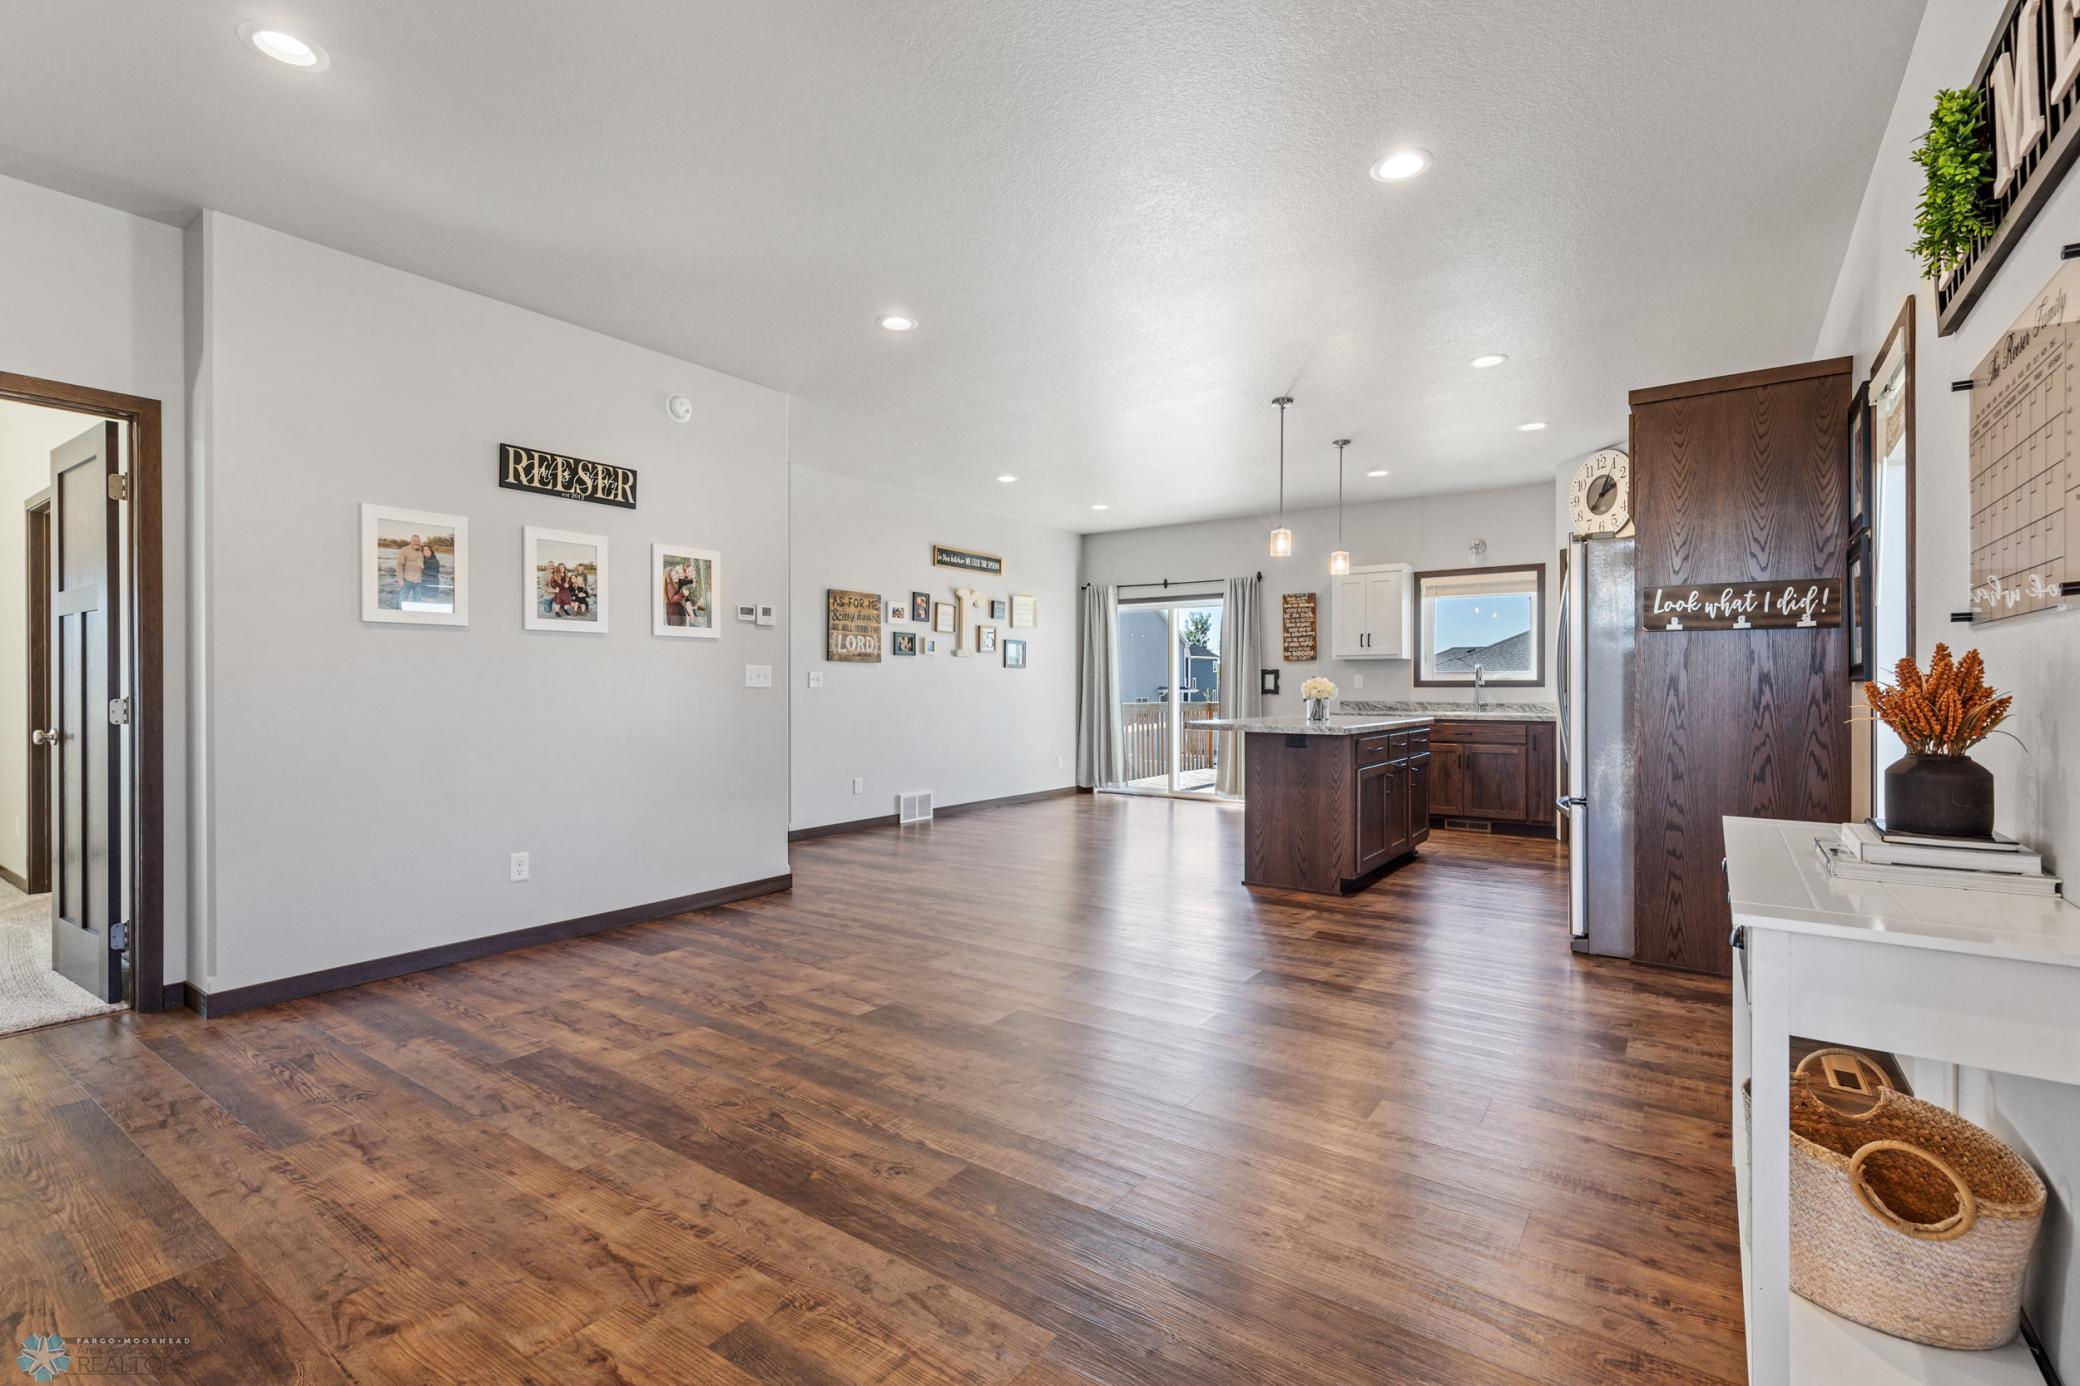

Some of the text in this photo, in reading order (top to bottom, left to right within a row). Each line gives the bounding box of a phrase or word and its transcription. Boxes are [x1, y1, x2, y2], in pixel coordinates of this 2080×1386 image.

[1987, 350, 2000, 386] The
[2033, 288, 2067, 338] Family
[1597, 456, 1607, 470] 12
[504, 445, 636, 504] REESER
[1586, 465, 1594, 478] 11
[1620, 466, 1627, 479] 2
[1578, 479, 1587, 492] 10
[1574, 495, 1580, 507] 9
[1577, 511, 1584, 522] 8
[1611, 514, 1618, 526] 5
[1586, 518, 1592, 531] 7
[1598, 520, 1605, 532] 6
[833, 596, 879, 611] AS FOR ME
[1653, 588, 1702, 615] Look
[1704, 587, 1758, 619] what
[1764, 591, 1771, 613] I
[838, 634, 874, 653] LORD
